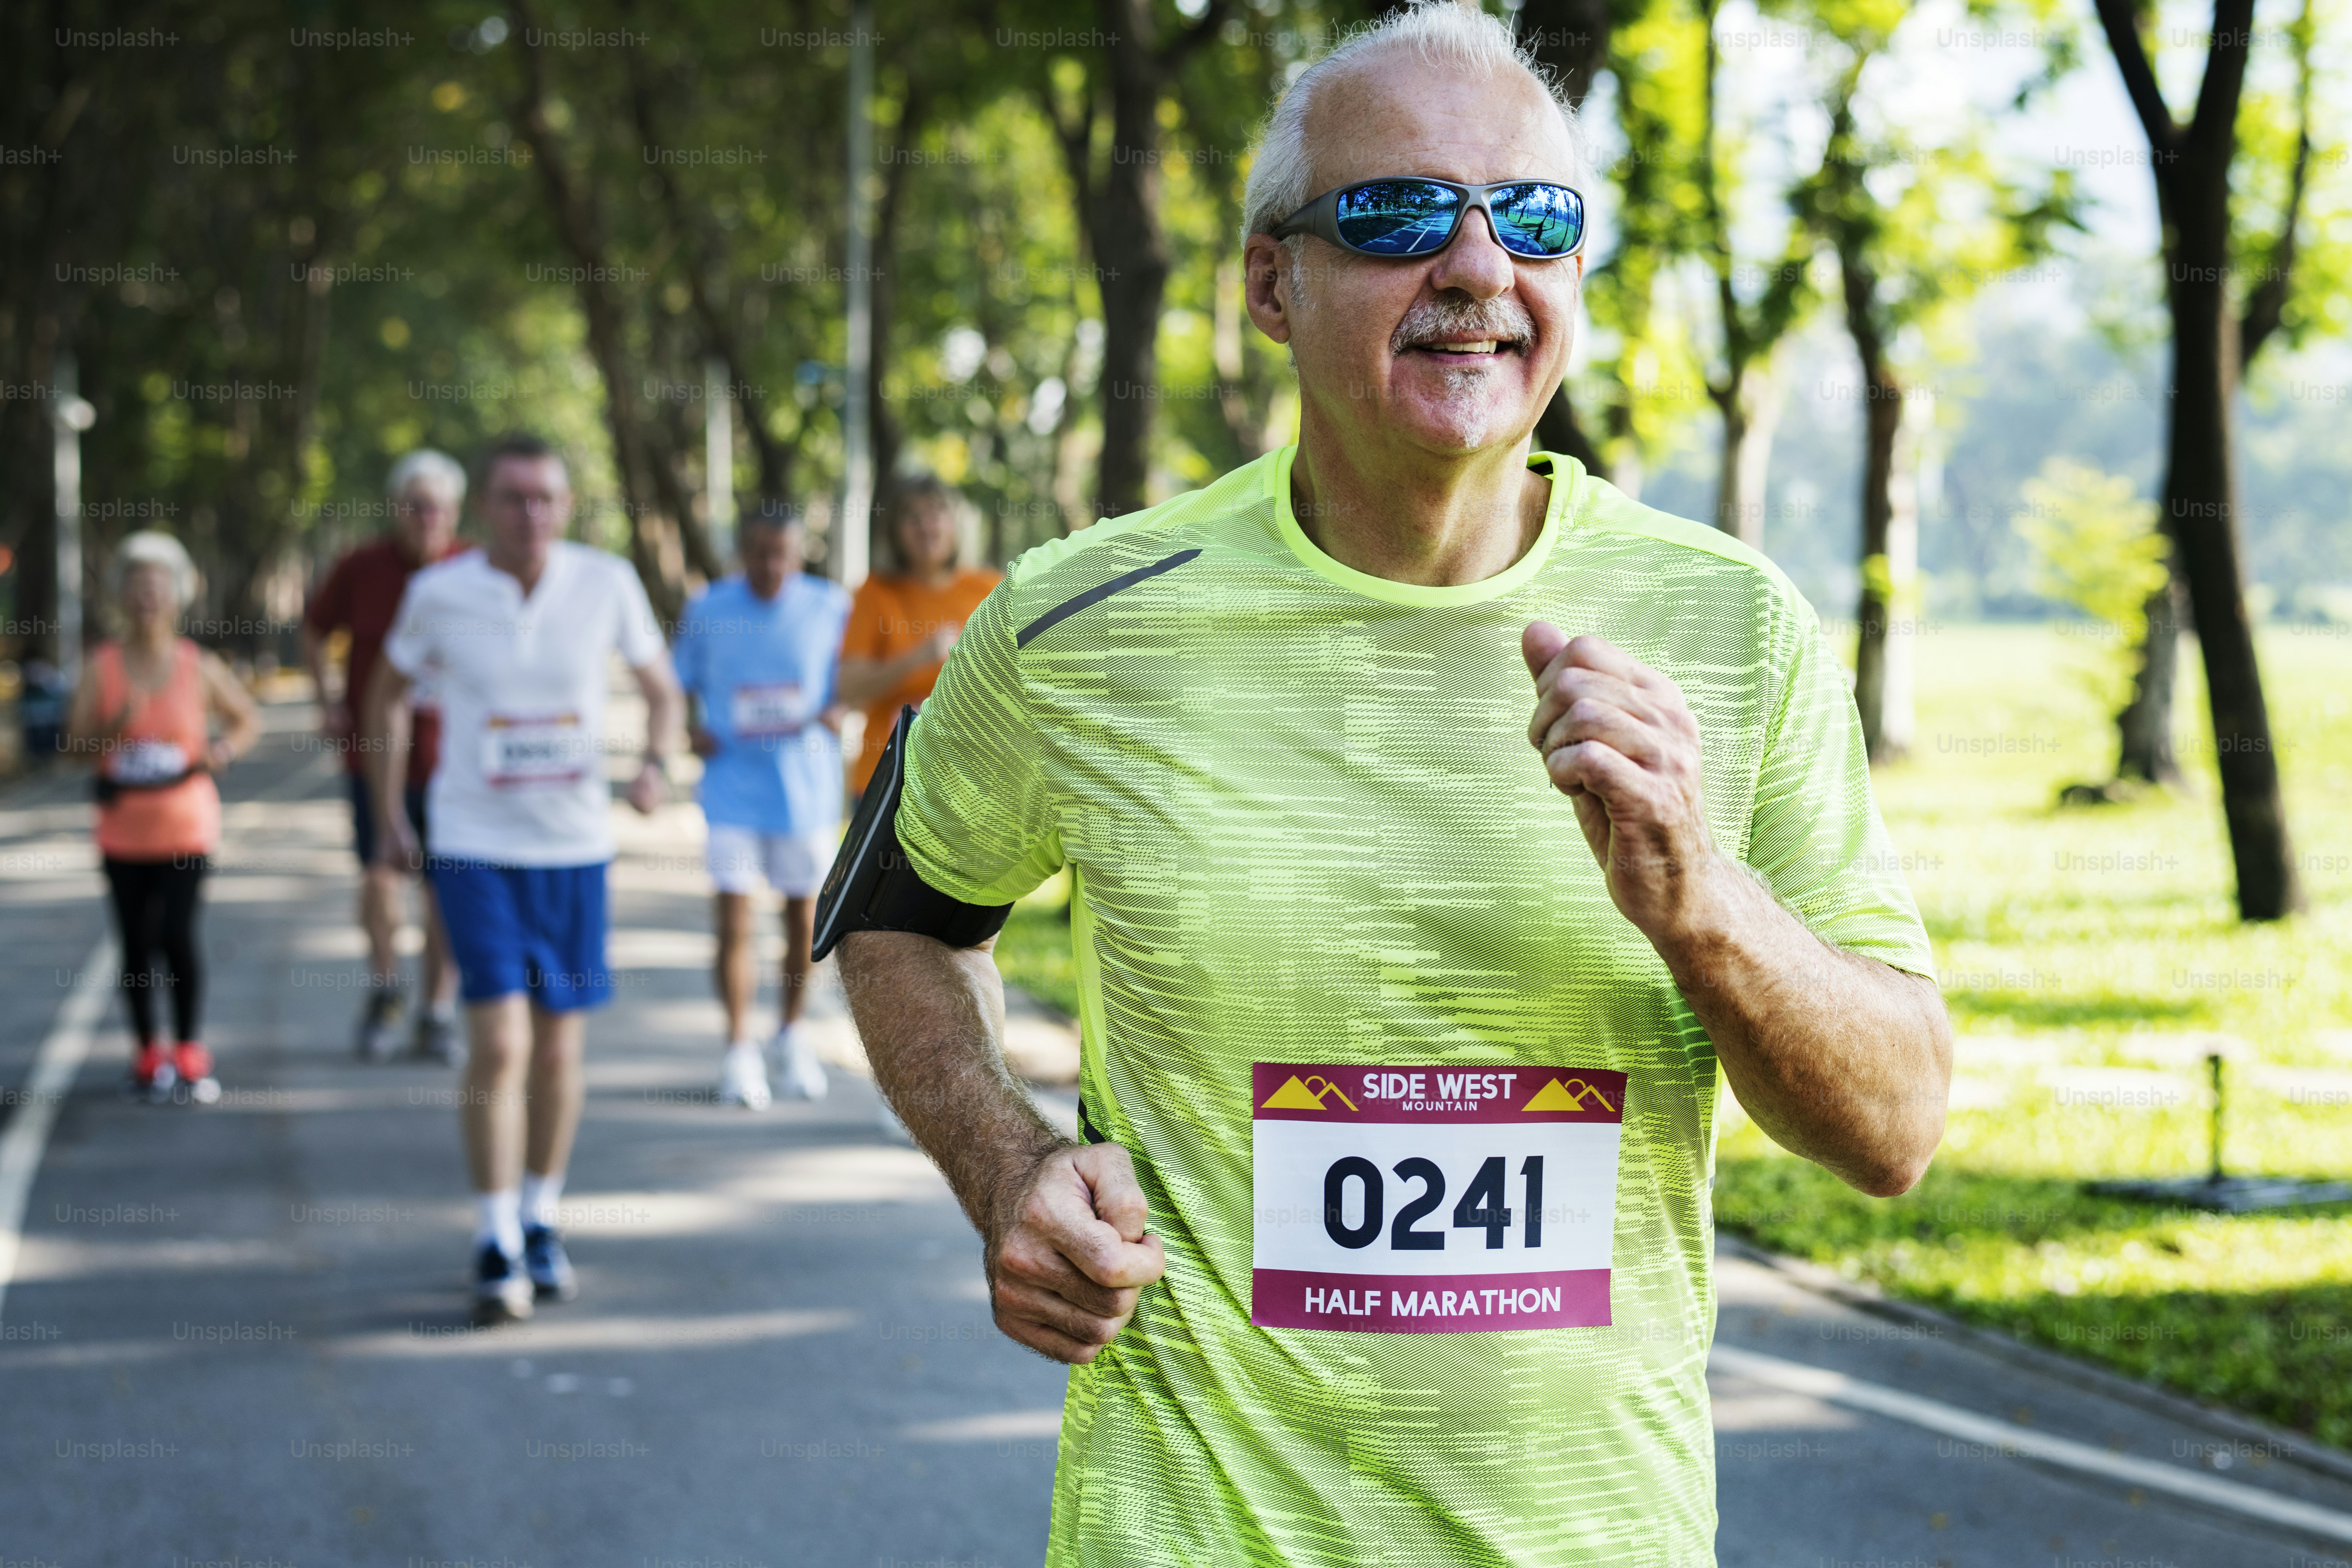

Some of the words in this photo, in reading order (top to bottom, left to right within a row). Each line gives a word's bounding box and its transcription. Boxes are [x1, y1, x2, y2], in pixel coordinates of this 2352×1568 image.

[1363, 1073, 1426, 1099] SIDE
[1437, 1073, 1517, 1099] WEST
[1402, 1101, 1478, 1111] MOUNTAIN
[1324, 1155, 1544, 1250] 0241
[1305, 1287, 1381, 1315] HALF
[1392, 1286, 1561, 1316] MARATHON
